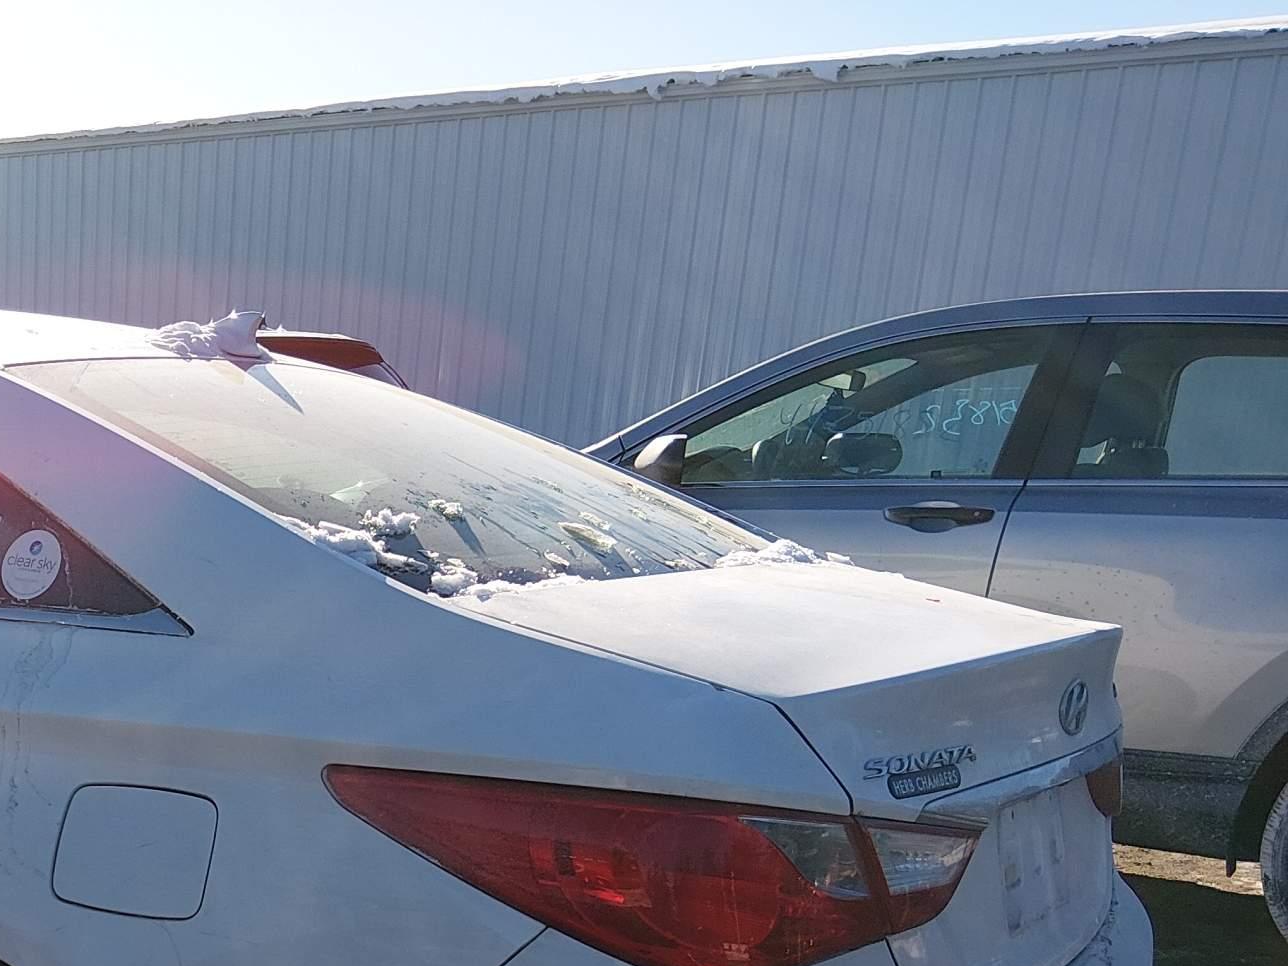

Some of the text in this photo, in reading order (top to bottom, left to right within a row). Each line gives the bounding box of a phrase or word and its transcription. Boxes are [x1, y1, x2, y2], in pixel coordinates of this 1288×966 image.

[7, 553, 57, 575] clear sky
[862, 744, 977, 780] SONATA
[892, 769, 959, 795] HERB CHAMBERS
